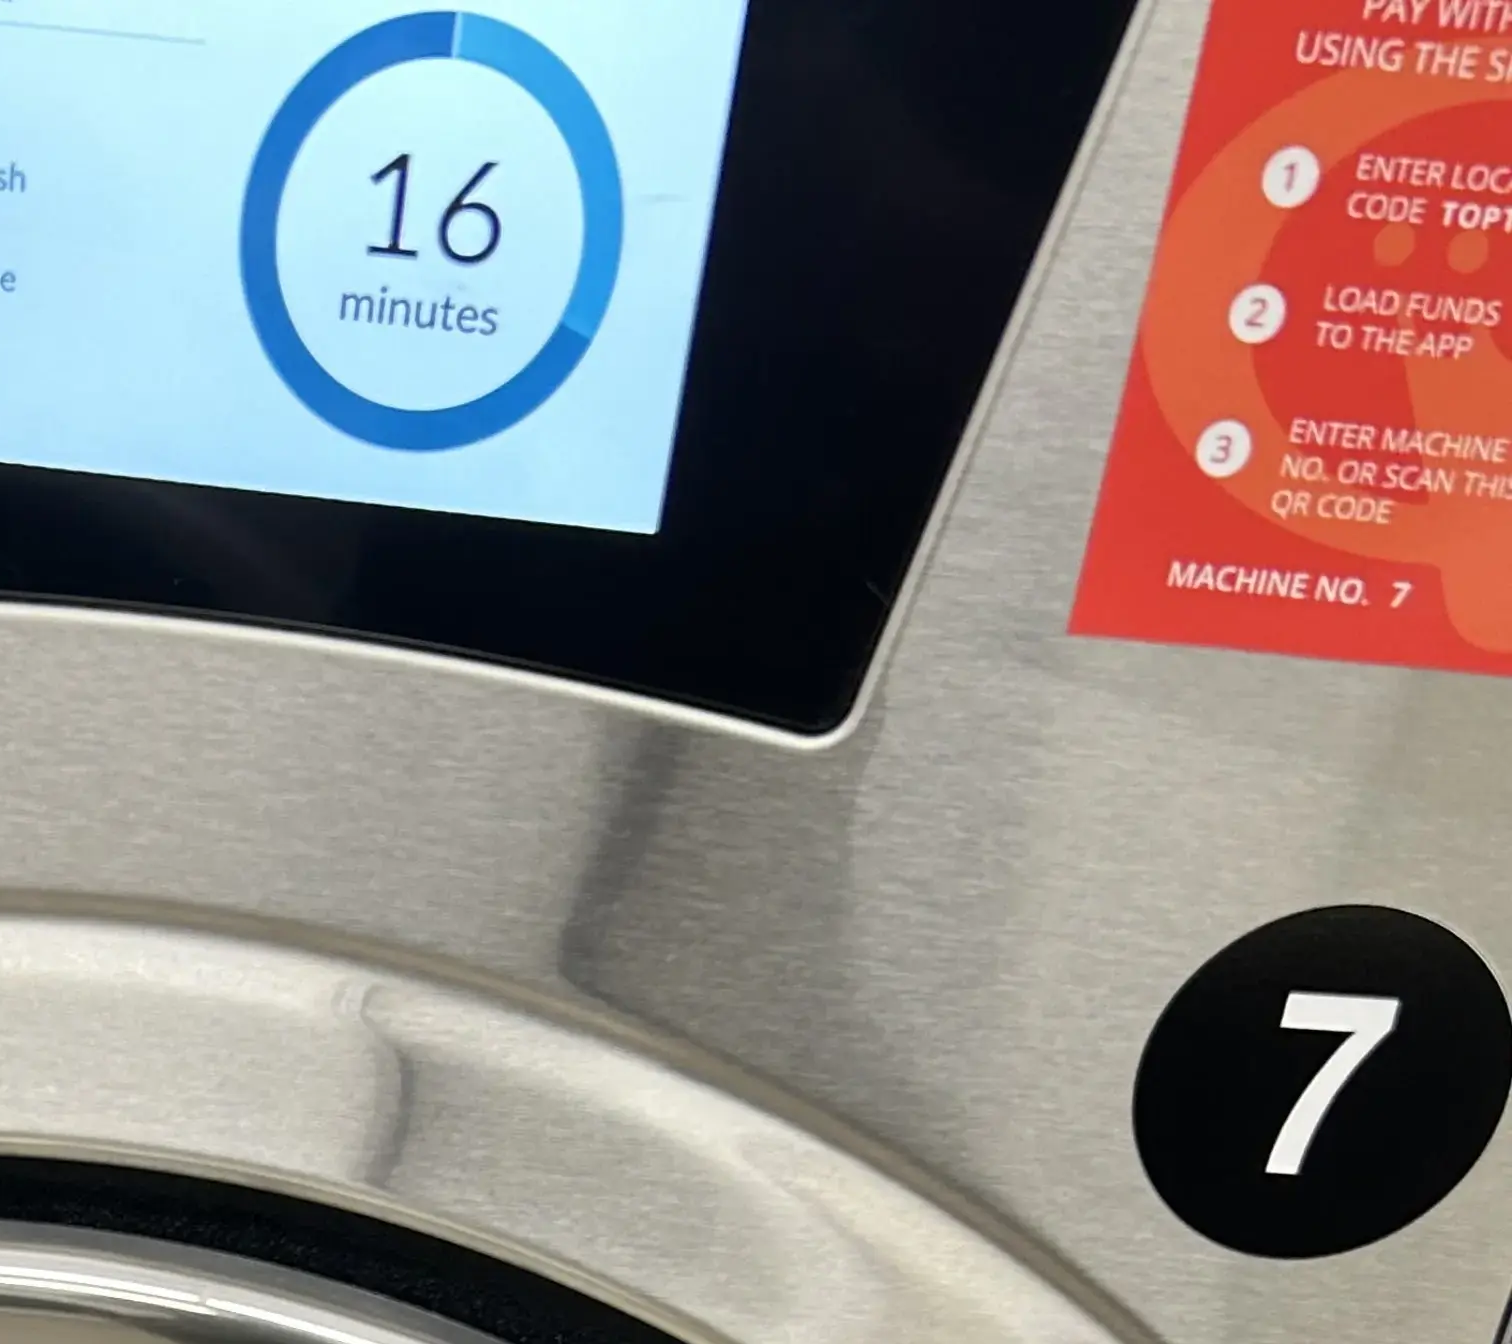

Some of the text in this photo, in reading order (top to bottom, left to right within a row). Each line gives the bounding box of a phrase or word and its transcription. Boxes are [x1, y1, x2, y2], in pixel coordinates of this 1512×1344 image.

[1362, 0, 1430, 25] PAY
[1295, 31, 1405, 72] USING
[1414, 40, 1481, 80] THE
[1282, 162, 1299, 192] 1
[1356, 153, 1512, 195] ENTER LOC
[366, 151, 503, 266] 16
[1347, 192, 1429, 224] CODE
[339, 283, 500, 338] minutes
[1244, 297, 1270, 326] 2
[1322, 286, 1502, 327] LOAD FUNDS
[1315, 321, 1473, 360] TO THE APP
[1209, 435, 1231, 464] 3
[1288, 418, 1510, 463] ENTER MACHINE
[1280, 454, 1330, 482] NO.
[1338, 461, 1377, 489] OR
[1381, 465, 1455, 494] SCAN
[1271, 490, 1395, 524] QR CODE
[1167, 560, 1412, 608] MACHINE NO. 7
[1264, 989, 1401, 1176] 7
